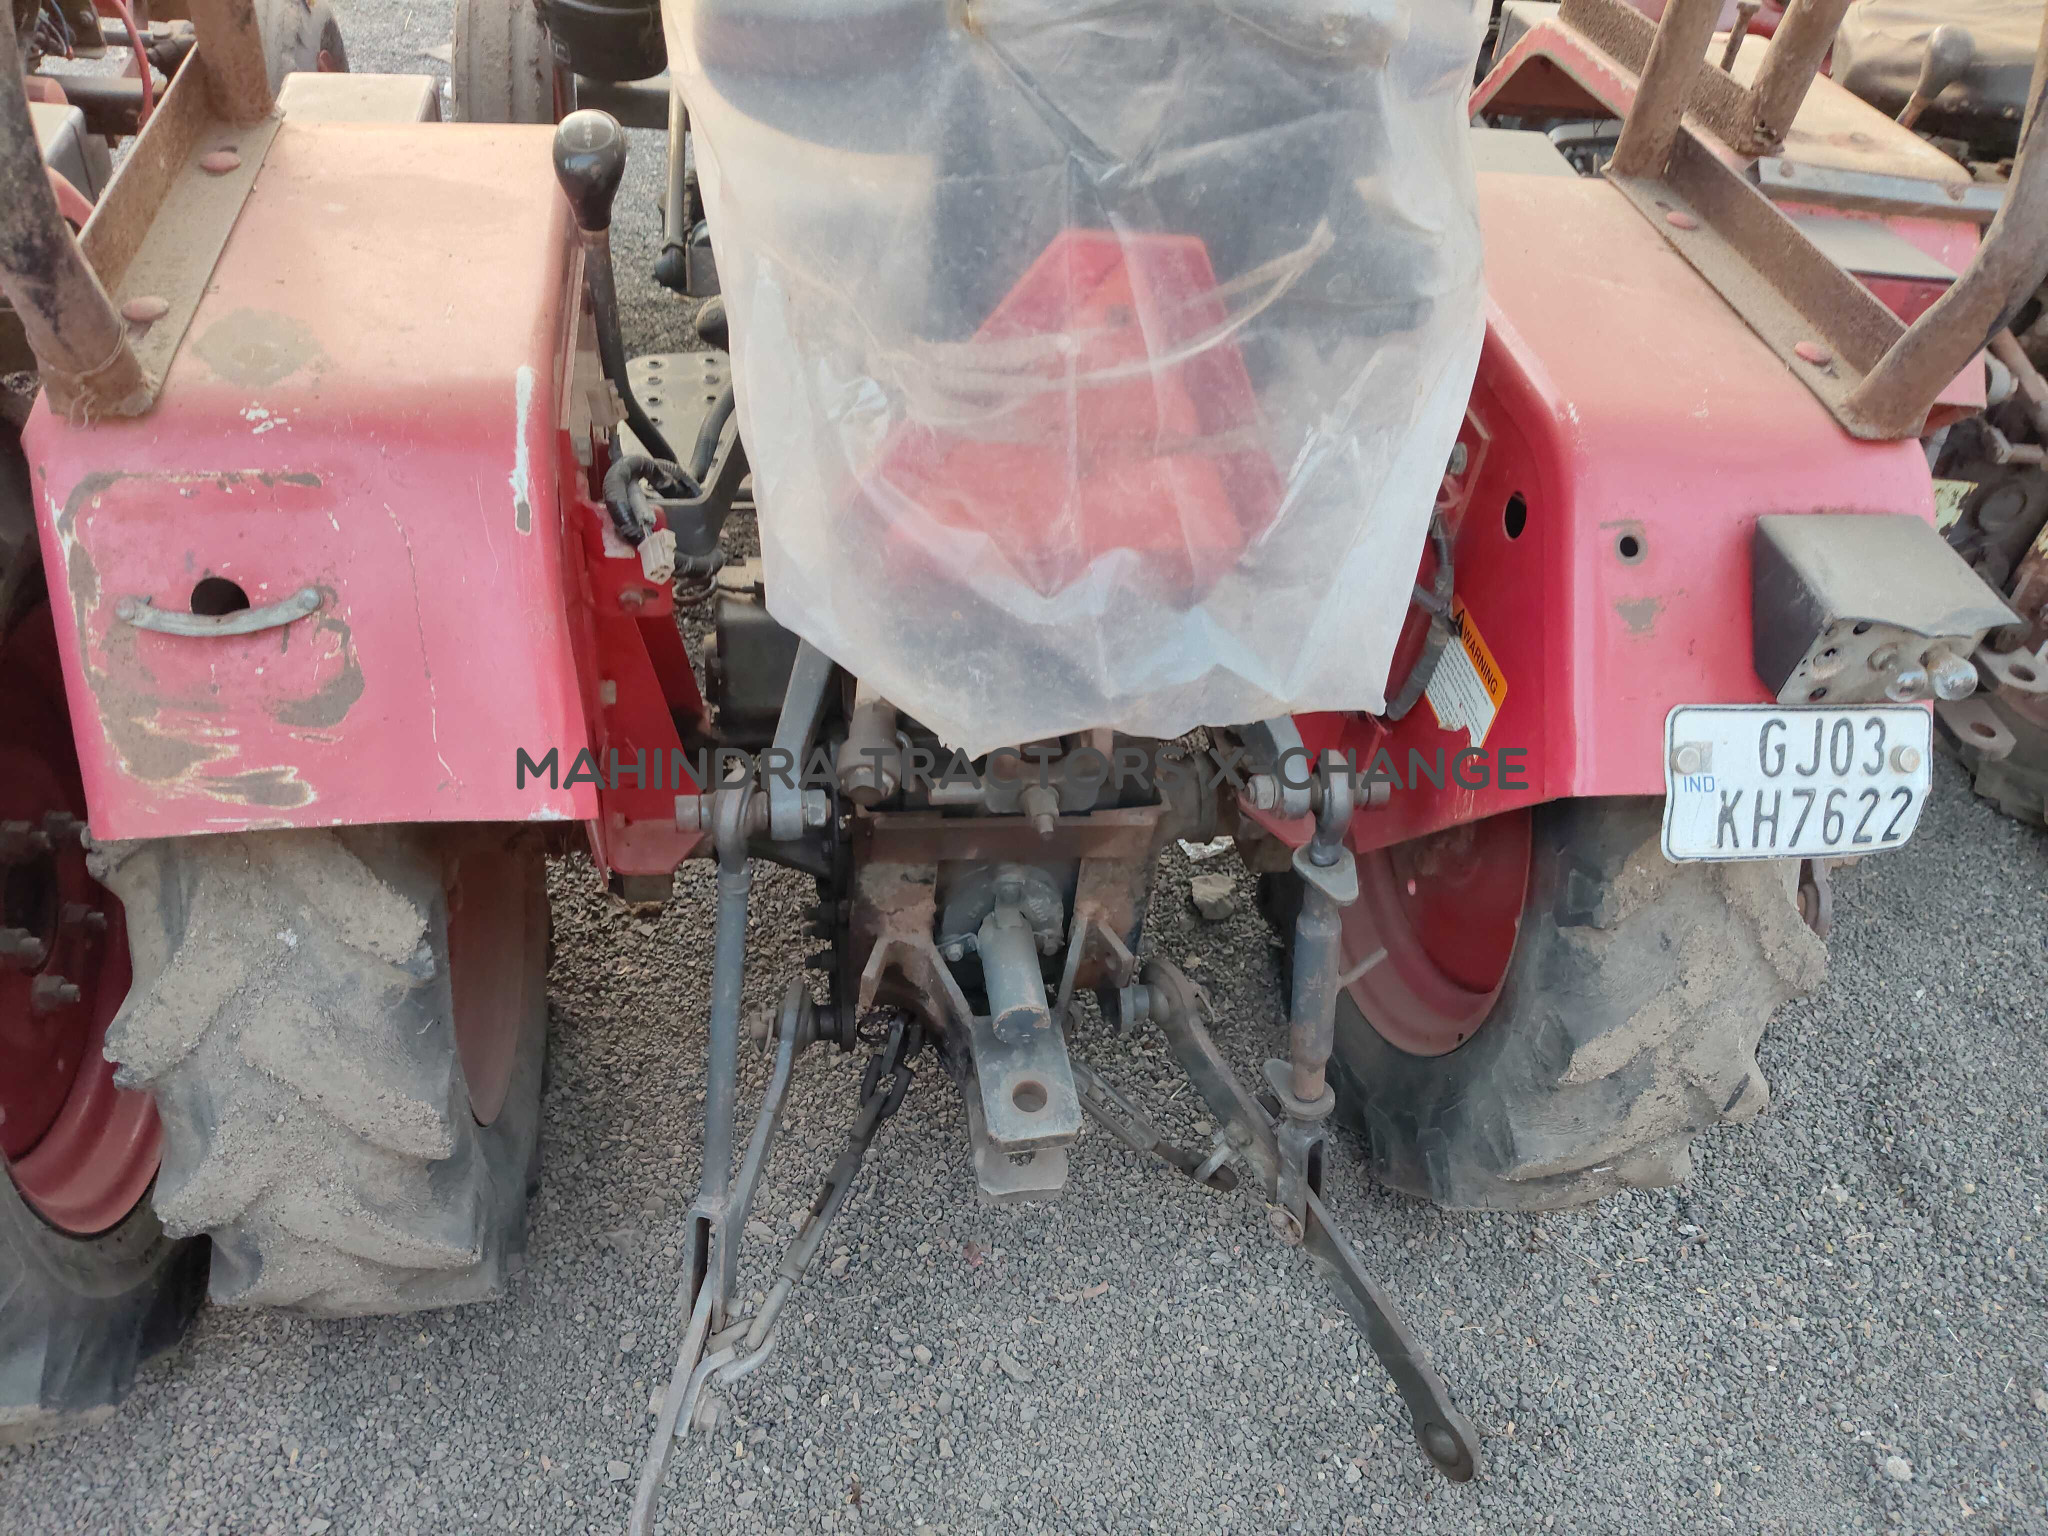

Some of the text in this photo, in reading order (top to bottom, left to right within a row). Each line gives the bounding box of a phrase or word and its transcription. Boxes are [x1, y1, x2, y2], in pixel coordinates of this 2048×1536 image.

[1463, 626, 1498, 696] WARNING
[1758, 717, 1886, 777] GJ03
[1683, 775, 1715, 793] IND
[1716, 785, 1913, 849] KH7622
